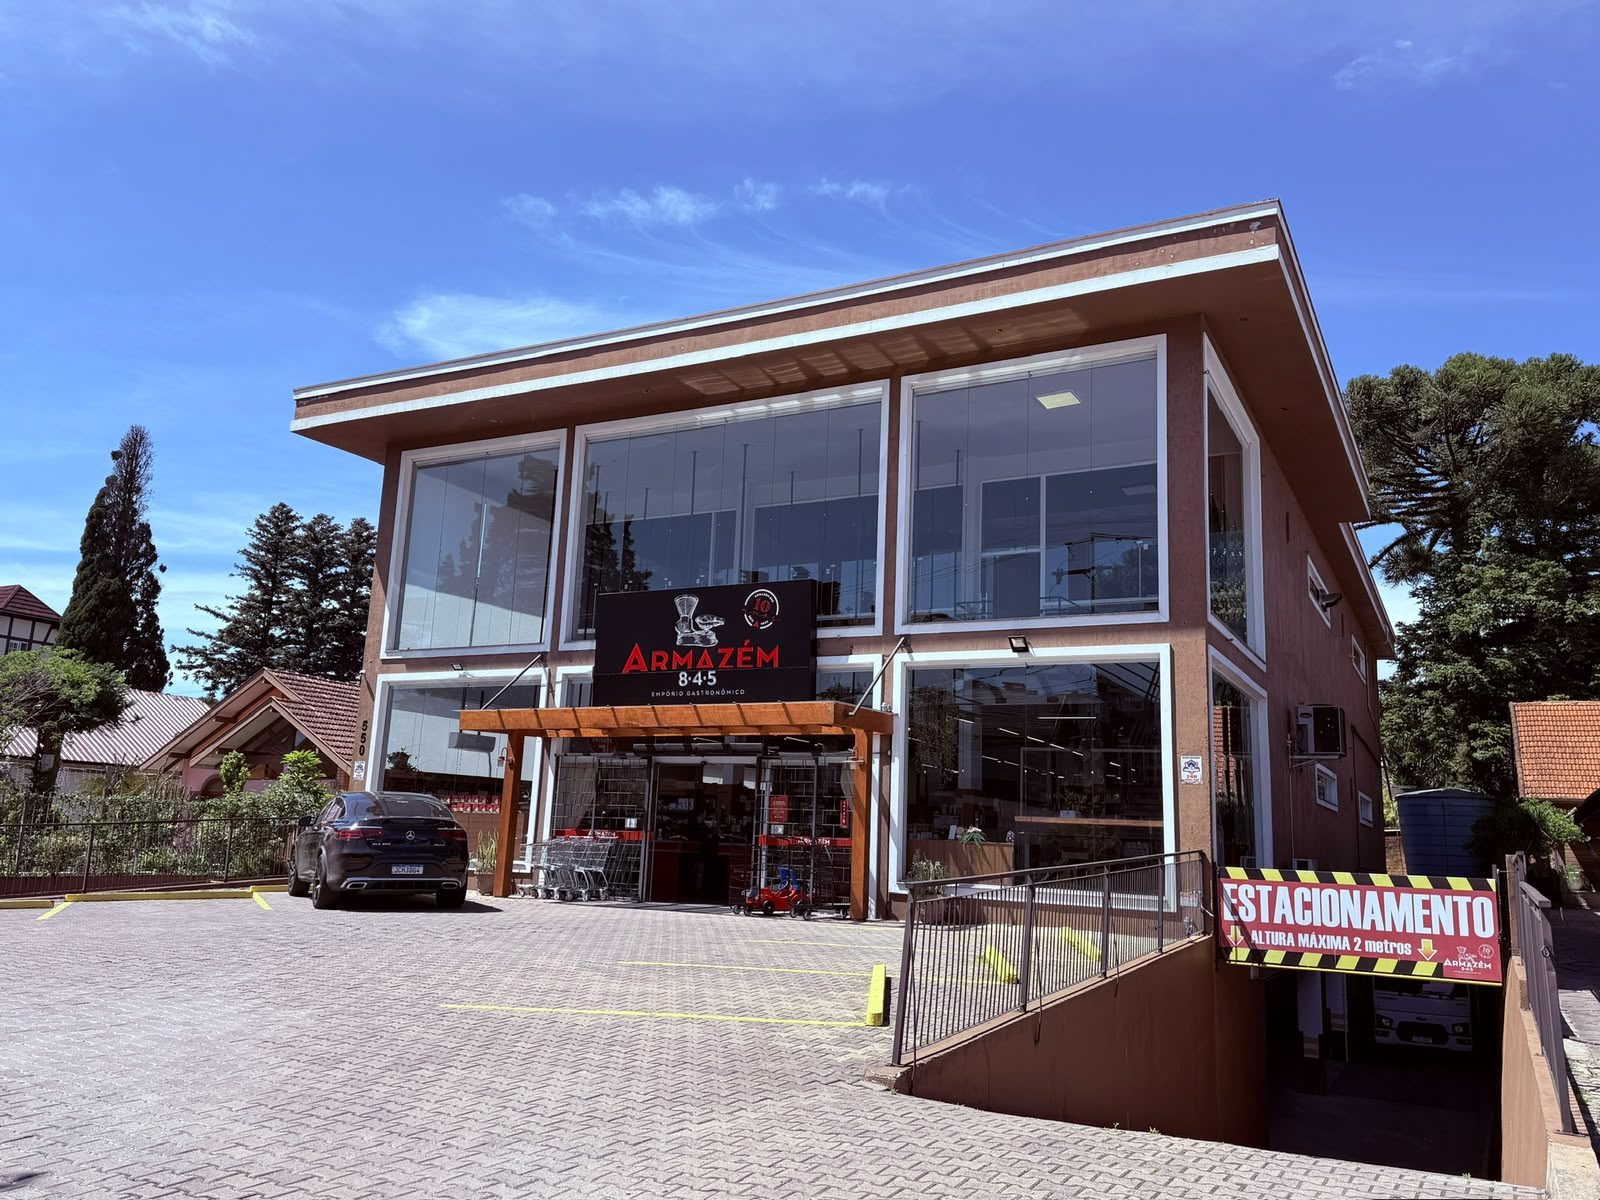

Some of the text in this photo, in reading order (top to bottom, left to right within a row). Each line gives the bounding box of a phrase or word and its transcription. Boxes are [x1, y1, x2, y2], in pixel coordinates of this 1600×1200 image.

[622, 640, 779, 673] ARMAZÉM
[359, 720, 368, 756] 550
[1223, 883, 1495, 938] ESTACIONAMENTO
[1251, 930, 1412, 955] ALTURA MÁXIMA 2 metros
[1443, 958, 1492, 970] ARMAZÉM
